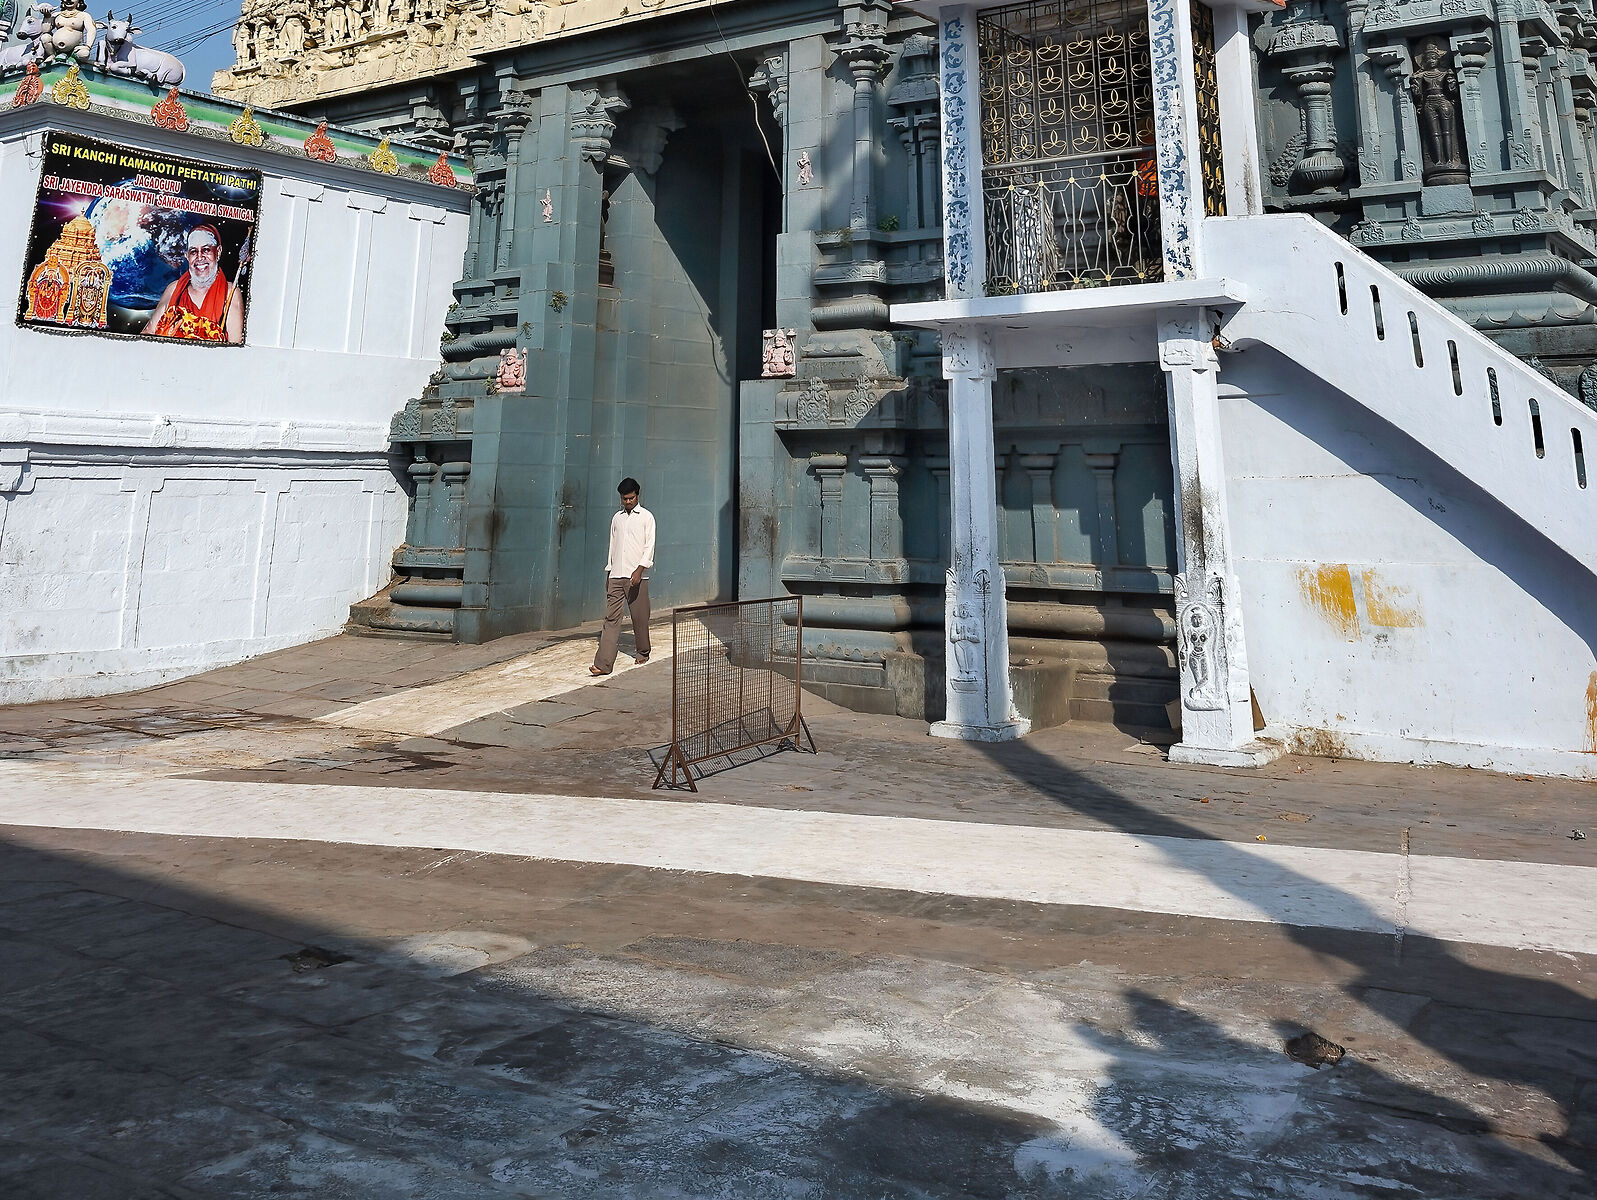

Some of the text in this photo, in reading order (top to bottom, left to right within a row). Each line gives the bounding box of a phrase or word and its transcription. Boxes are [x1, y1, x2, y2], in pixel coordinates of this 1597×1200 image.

[51, 142, 257, 191] SRI KANCHI KAMAKOTI PEETATHI PATHI
[134, 173, 182, 194] JAGADGURU
[43, 175, 254, 222] SRI JAYENDRA SARASWATHI SANKARACHARYA SWAMIGAL
